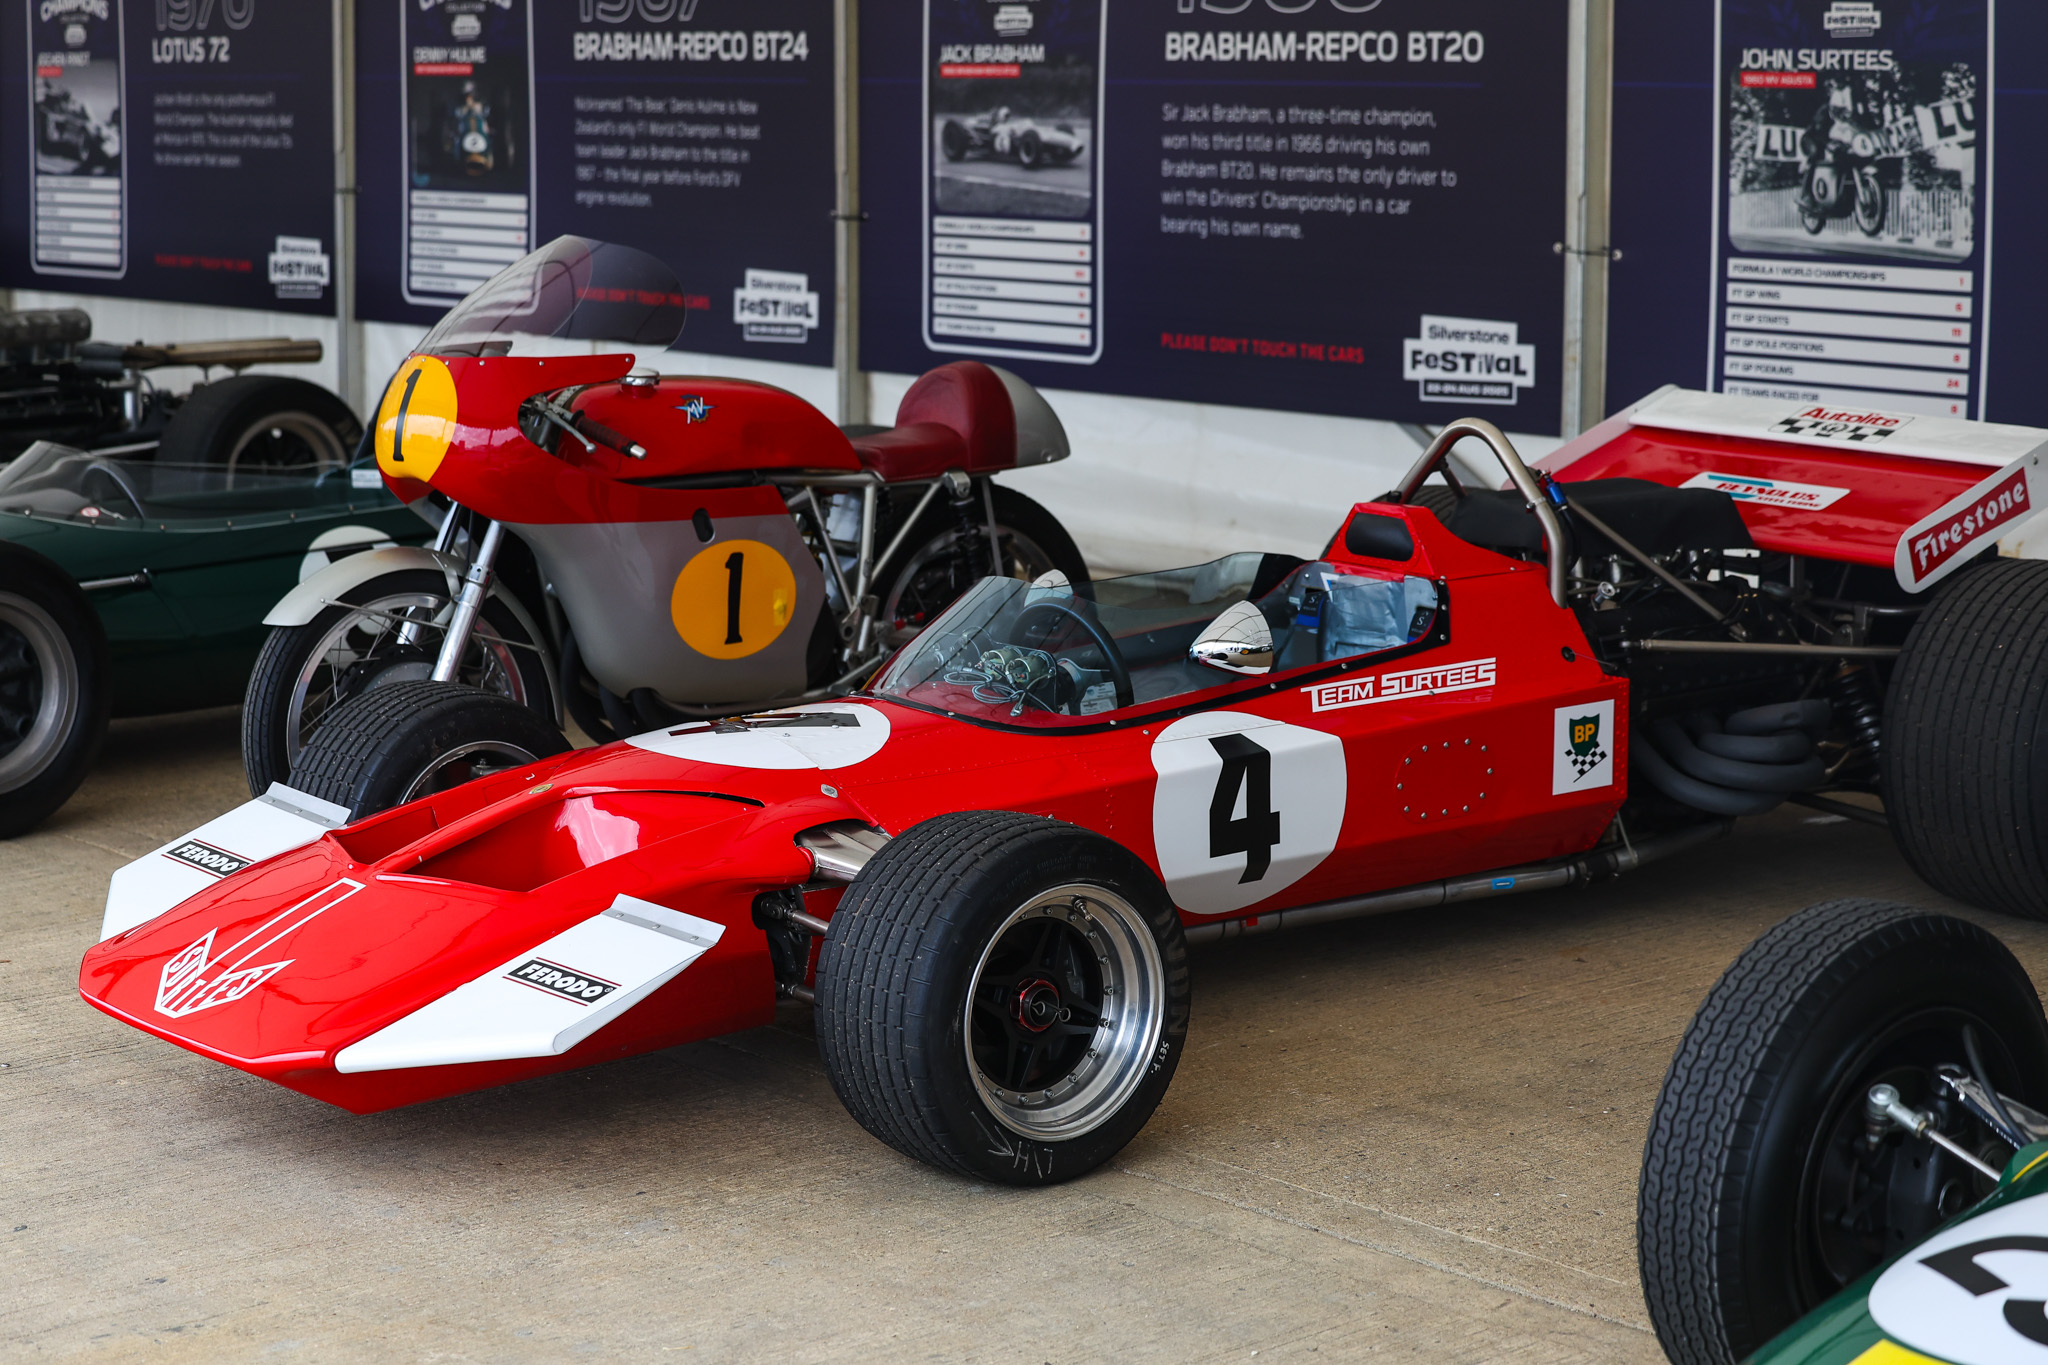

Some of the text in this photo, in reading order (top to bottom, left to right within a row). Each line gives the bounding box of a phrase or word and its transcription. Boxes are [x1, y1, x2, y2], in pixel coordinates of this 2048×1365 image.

[152, 35, 231, 63] LOTUS 72
[573, 31, 809, 62] BRABHAM-REPCO BT24
[940, 44, 1046, 63] JACK BRABHAM
[1164, 31, 1485, 63] BRABHAM-REPCO BT20
[1740, 48, 1894, 71] JOHN SURTEES
[1181, 103, 1210, 122] Jack
[1276, 107, 1287, 123] a
[1288, 104, 1361, 125] three-time
[1363, 104, 1437, 129] champion,
[1161, 134, 1188, 149] won
[1190, 131, 1210, 150] his
[1212, 132, 1244, 151] third
[1245, 132, 1274, 152] title
[1275, 133, 1289, 152] in
[1325, 134, 1373, 159] driving
[1375, 135, 1397, 155] his
[1399, 139, 1430, 156] own
[1161, 158, 1219, 178] Brabham
[1259, 162, 1278, 180] He
[1280, 163, 1334, 183] remains
[1337, 164, 1361, 184] the
[1363, 165, 1394, 189] only
[1396, 166, 1437, 186] driver
[1440, 168, 1457, 188] to
[1161, 187, 1184, 206] win
[1185, 187, 1208, 206] the
[1261, 190, 1357, 216] Championship
[1358, 193, 1373, 212] in
[1375, 198, 1385, 214] a
[1387, 198, 1411, 215] car
[1160, 214, 1208, 239] bearing
[1209, 216, 1230, 236] his
[1231, 220, 1260, 236] own
[1161, 332, 1365, 364] PLEASE DON'T TOUCH THE CARS
[1428, 323, 1511, 344] Silverstone
[393, 368, 422, 462] 1
[687, 396, 704, 424] MV
[1801, 406, 1900, 428] Autolite
[1914, 481, 2025, 571] Firestone
[724, 552, 744, 645] 1
[1300, 657, 1496, 713] TEAM SURTEES
[1573, 723, 1596, 744] BP
[1208, 733, 1280, 885] 4
[174, 843, 240, 873] FERODO
[516, 963, 604, 998] FERODO
[1158, 1040, 1170, 1062] SET
